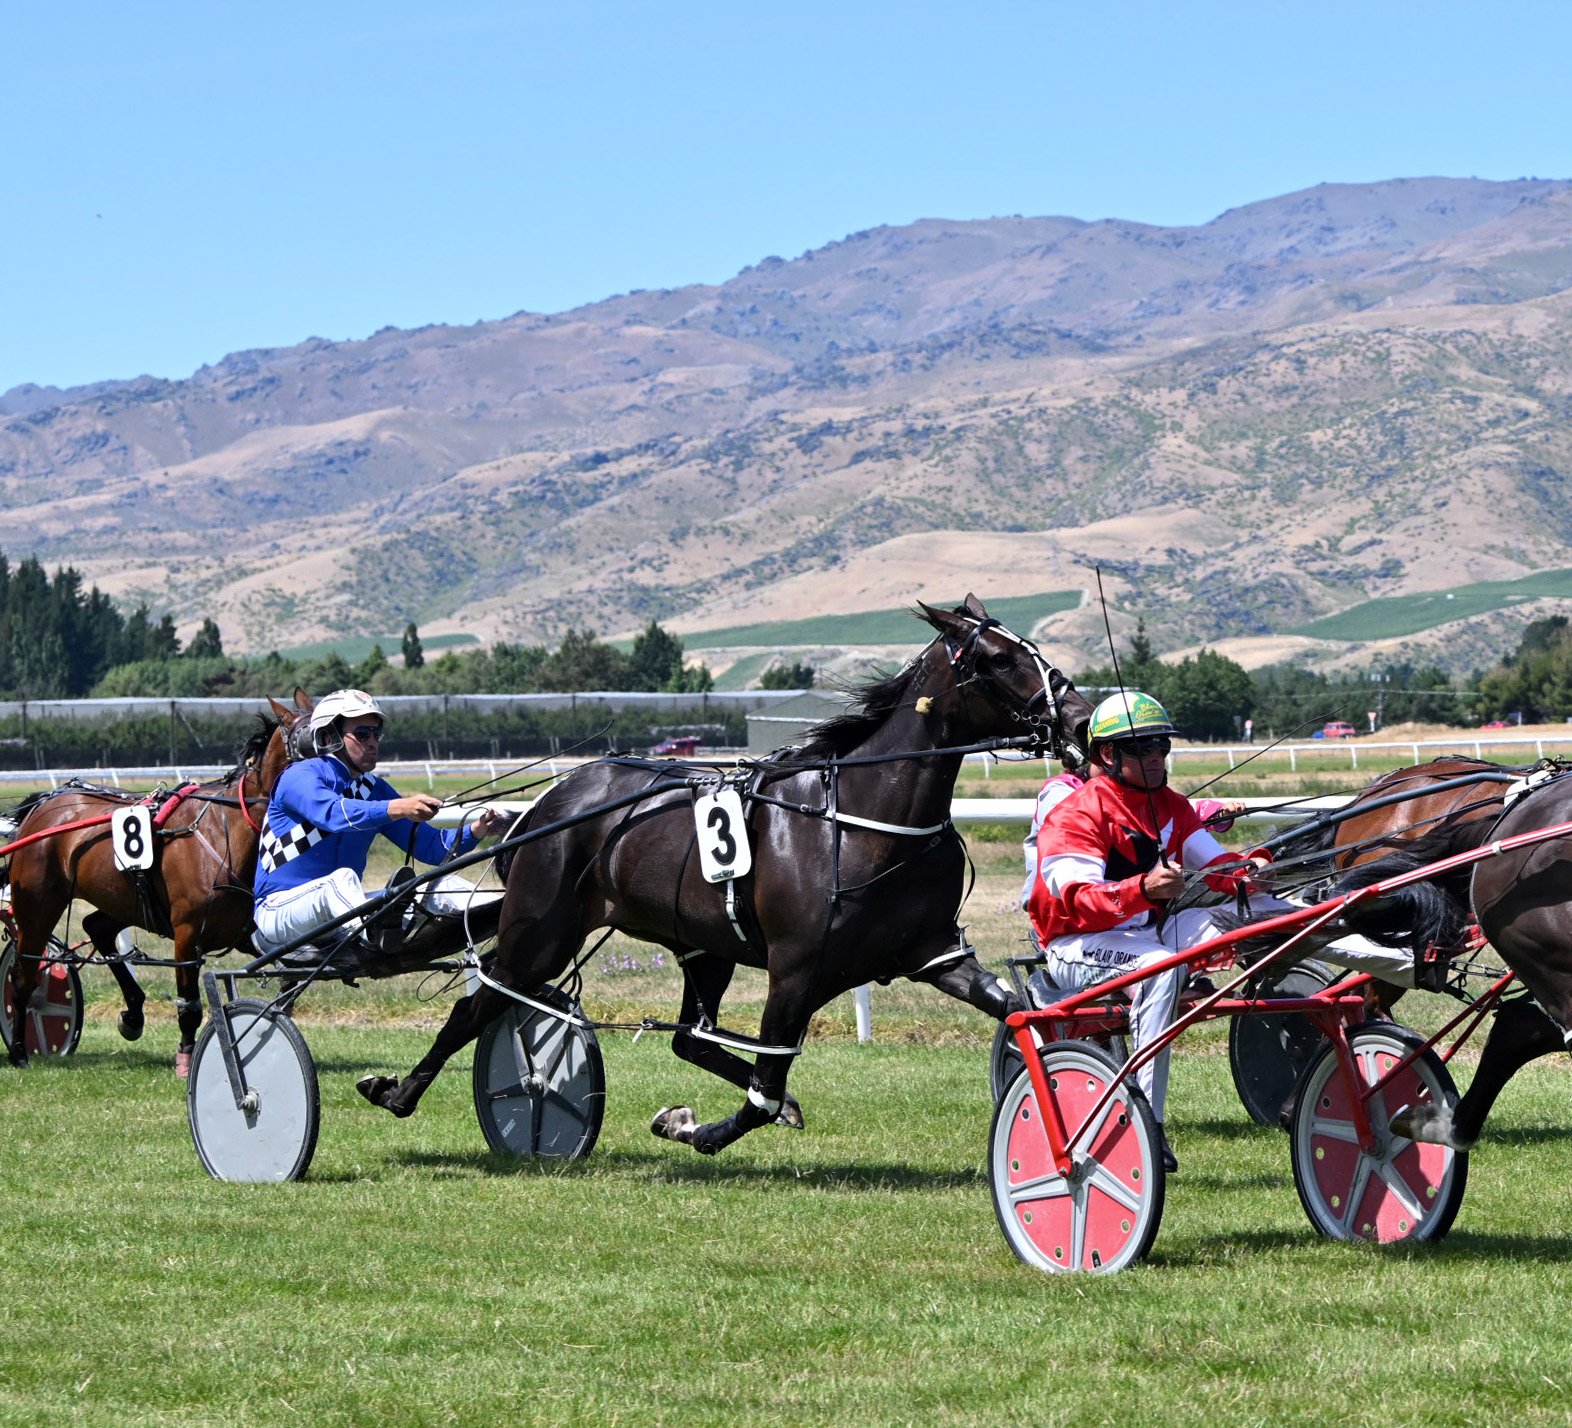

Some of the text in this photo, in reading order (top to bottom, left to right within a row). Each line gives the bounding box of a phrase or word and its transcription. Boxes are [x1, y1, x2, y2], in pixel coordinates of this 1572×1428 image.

[122, 815, 144, 860] 8
[707, 806, 737, 866] 3
[1094, 948, 1140, 968] BLAIR ORANGE
